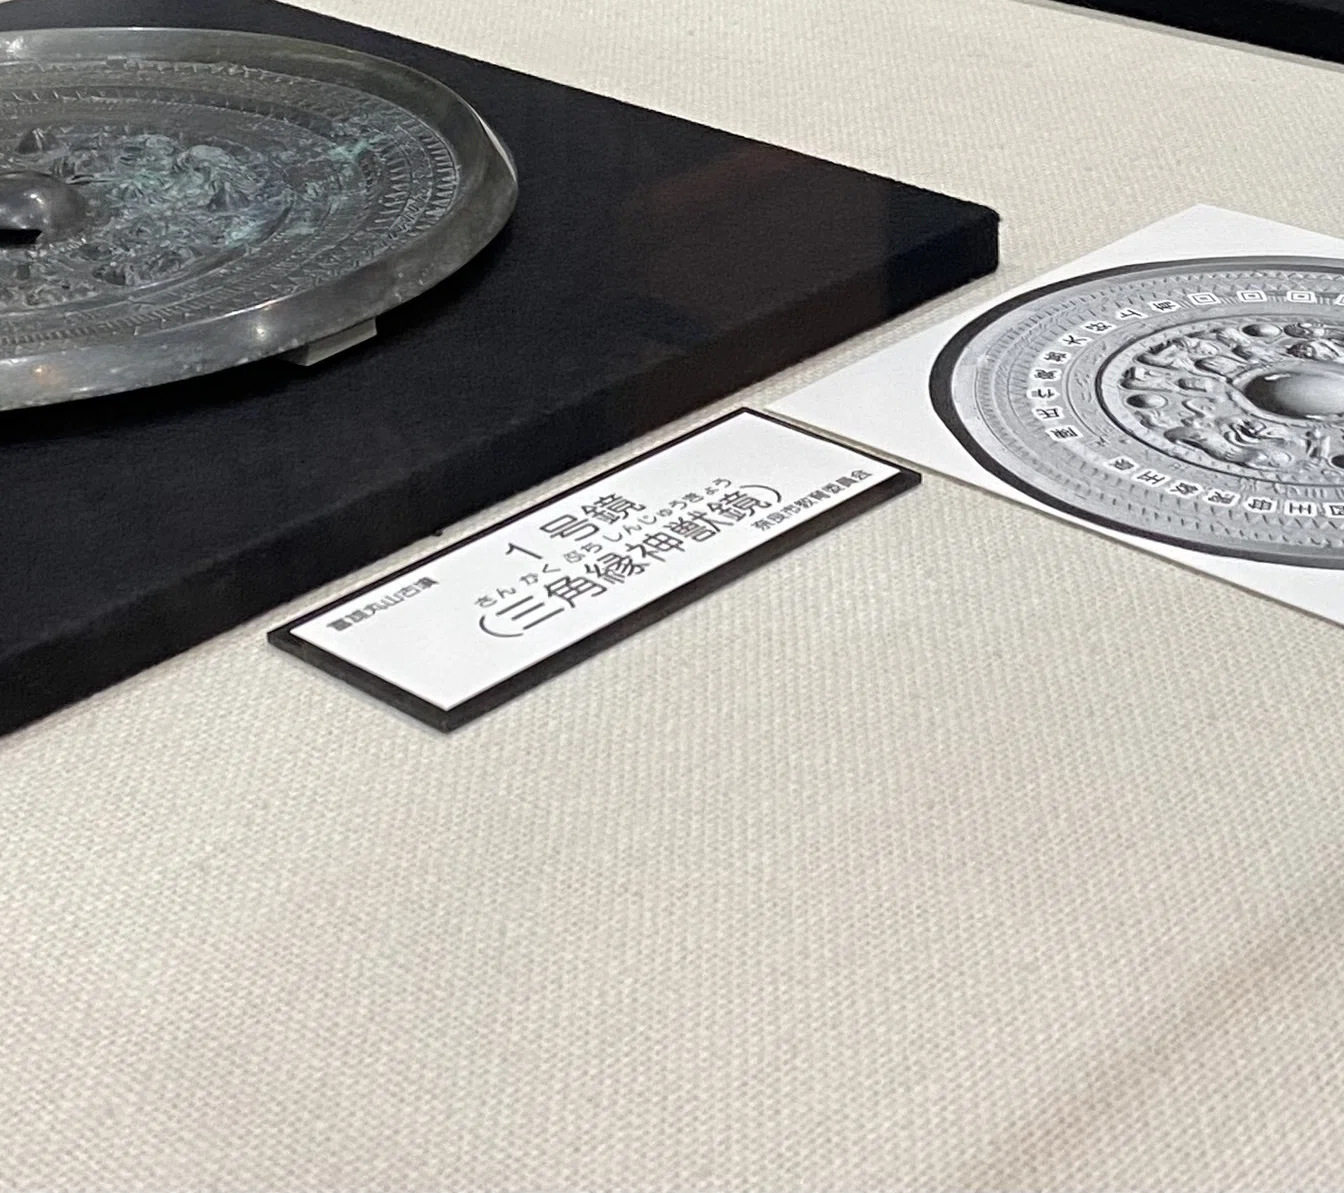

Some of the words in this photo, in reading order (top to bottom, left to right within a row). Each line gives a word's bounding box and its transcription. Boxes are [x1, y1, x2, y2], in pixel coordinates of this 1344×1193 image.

[478, 484, 782, 638] (三角縁神獣鏡)
[505, 493, 648, 560] 1号鏡
